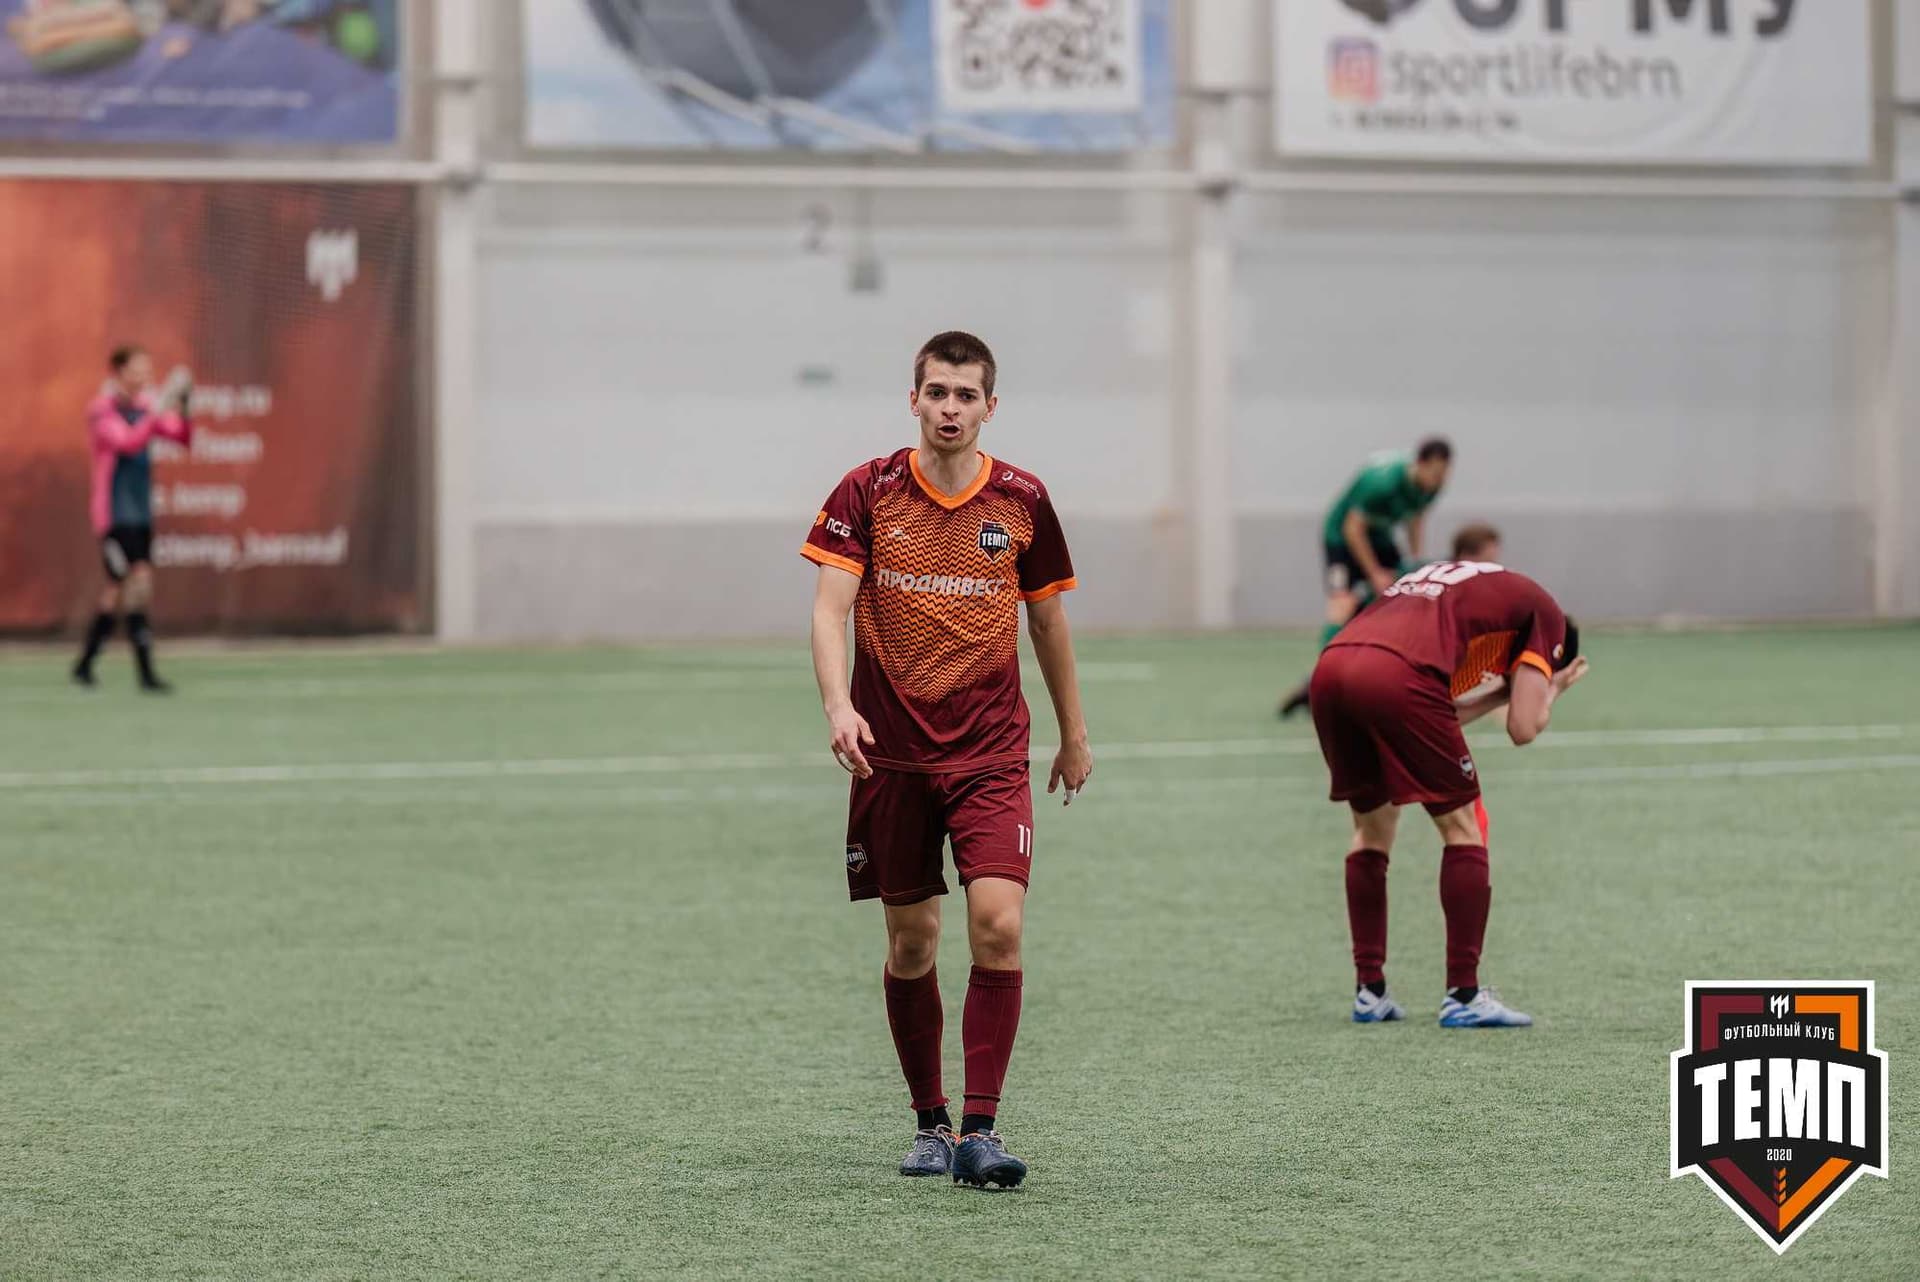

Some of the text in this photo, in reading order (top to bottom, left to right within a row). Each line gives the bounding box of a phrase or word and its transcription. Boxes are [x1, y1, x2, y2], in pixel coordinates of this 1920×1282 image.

[826, 517, 852, 537] ПСБ
[981, 532, 1009, 549] ТЕМП
[1017, 824, 1031, 857] 11
